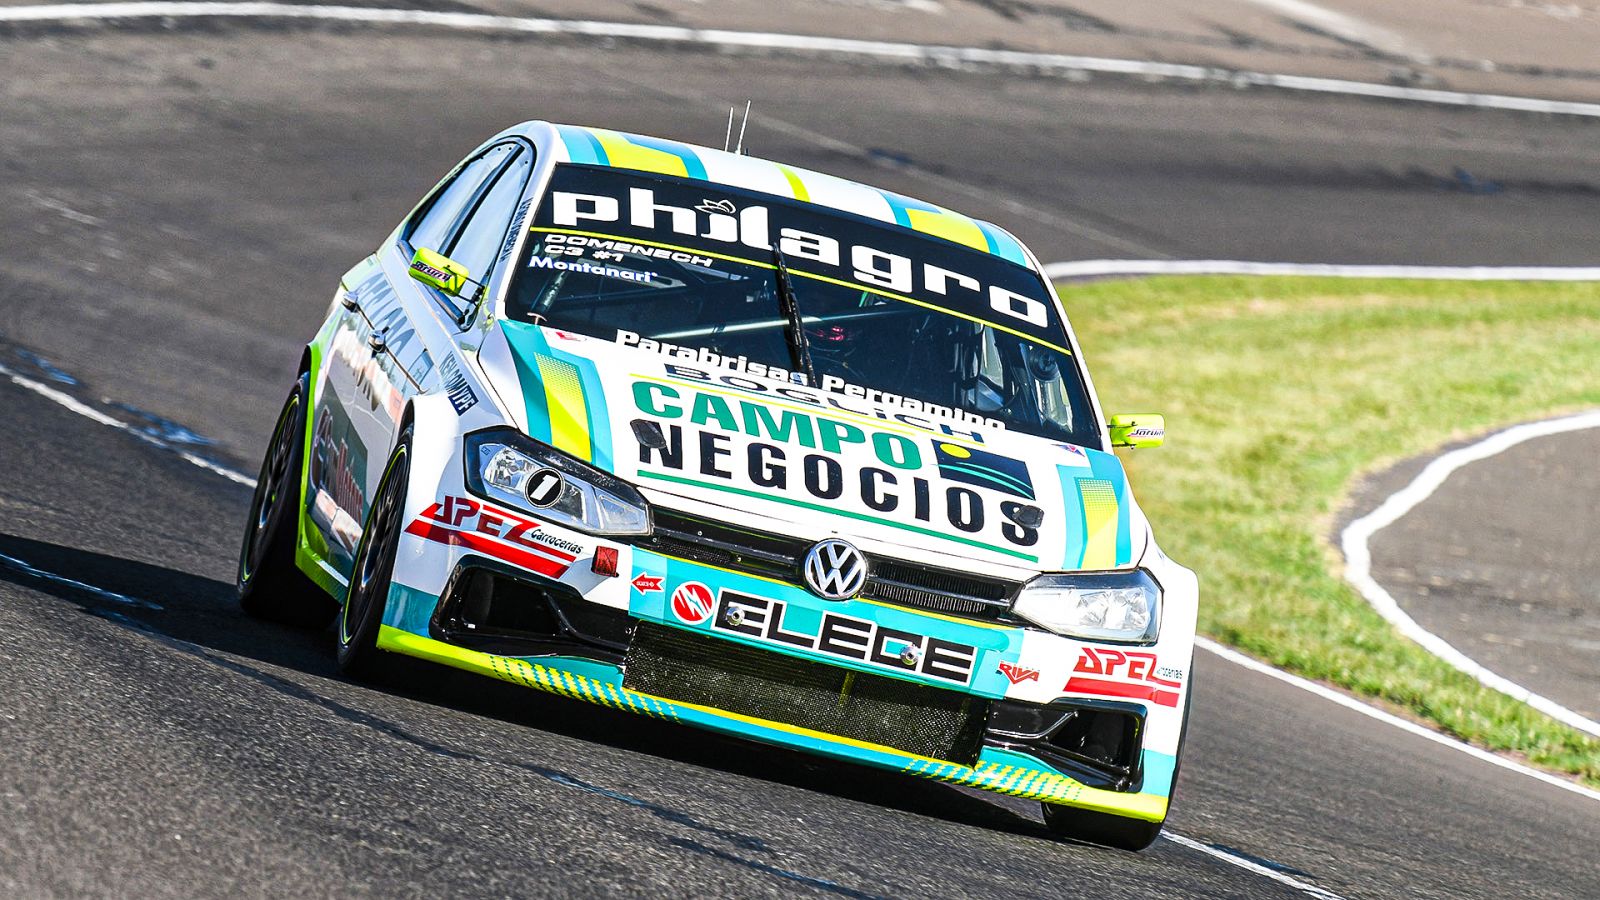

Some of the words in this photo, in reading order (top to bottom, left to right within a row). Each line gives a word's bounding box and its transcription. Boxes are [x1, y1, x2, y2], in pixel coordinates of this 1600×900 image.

[544, 234, 713, 267] DOMENECH
[544, 244, 584, 257] C3
[592, 250, 625, 262] #1
[552, 187, 1048, 328] philagro
[616, 328, 809, 387] Parabrisas
[822, 373, 1006, 431] Pergamino
[451, 387, 475, 411] YPF
[631, 381, 924, 471] CAMPO
[529, 474, 560, 501] 1
[637, 421, 1040, 547] NEGOCIOS
[530, 528, 584, 554] Carrocerias
[999, 663, 1039, 684] RIVA
